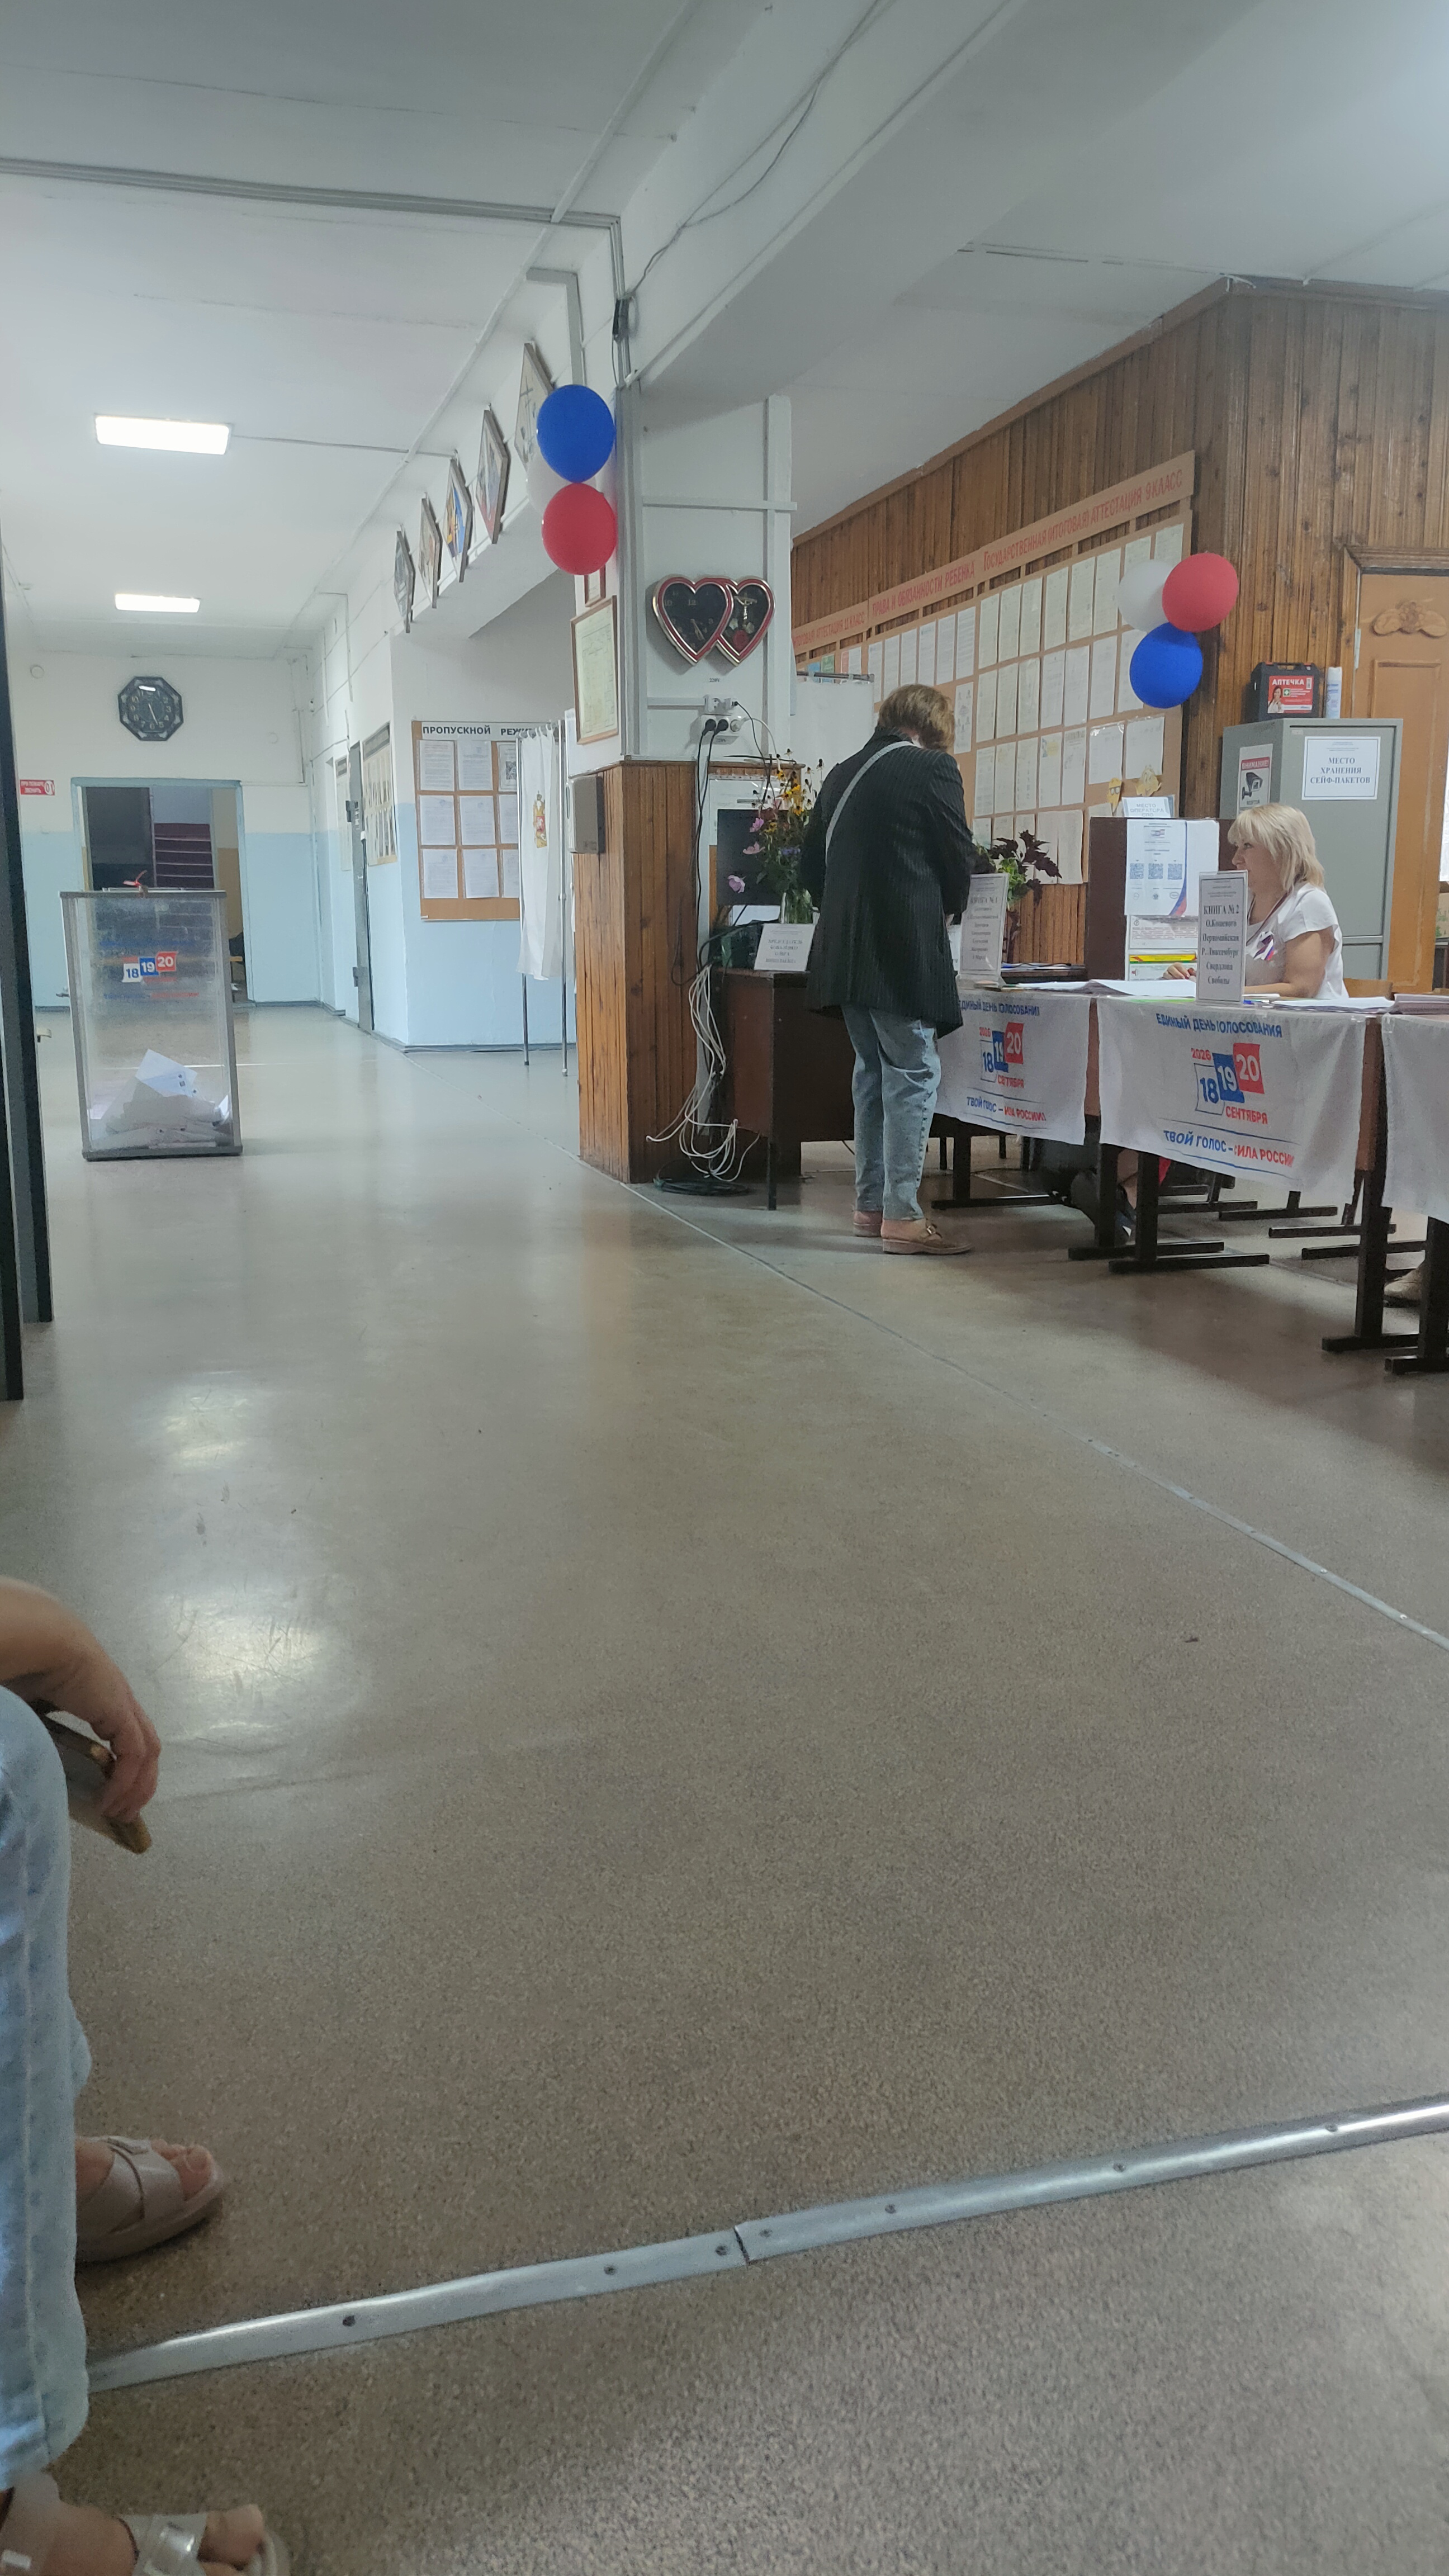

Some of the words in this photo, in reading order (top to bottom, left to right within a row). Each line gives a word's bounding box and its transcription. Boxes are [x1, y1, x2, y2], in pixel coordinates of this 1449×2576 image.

[1091, 486, 1143, 525] АТТЕСТАЦИЯ
[872, 597, 889, 618] ПРАВА
[891, 595, 896, 610] И
[898, 575, 943, 607] ОБЯЗАННОСТИ
[945, 561, 975, 588] РЕБЕНКА
[423, 725, 491, 735] ПРОПУСКНОЙ
[1204, 905, 1227, 915] КНИГА
[1228, 905, 1235, 915] №
[1235, 905, 1239, 914] 2
[1202, 933, 1239, 944] Первомайская
[141, 962, 155, 973] 19
[157, 956, 174, 967] 20
[126, 968, 139, 978] 18
[1156, 1014, 1191, 1030] ЕДИНЫЙ
[1192, 1017, 1216, 1032] ДЕНЬ
[1006, 1031, 1021, 1055] 20
[983, 1051, 994, 1073] 18
[1191, 1048, 1211, 1060] 2026
[1236, 1054, 1259, 1082] 20
[1217, 1066, 1238, 1092] 19
[1200, 1077, 1219, 1104] 18
[967, 1096, 982, 1108] ТВОЙ
[1225, 1106, 1268, 1125] СЕНТЯБРЯ
[1163, 1130, 1194, 1146] ТВОЙ
[1196, 1136, 1227, 1152] ГОЛОС
